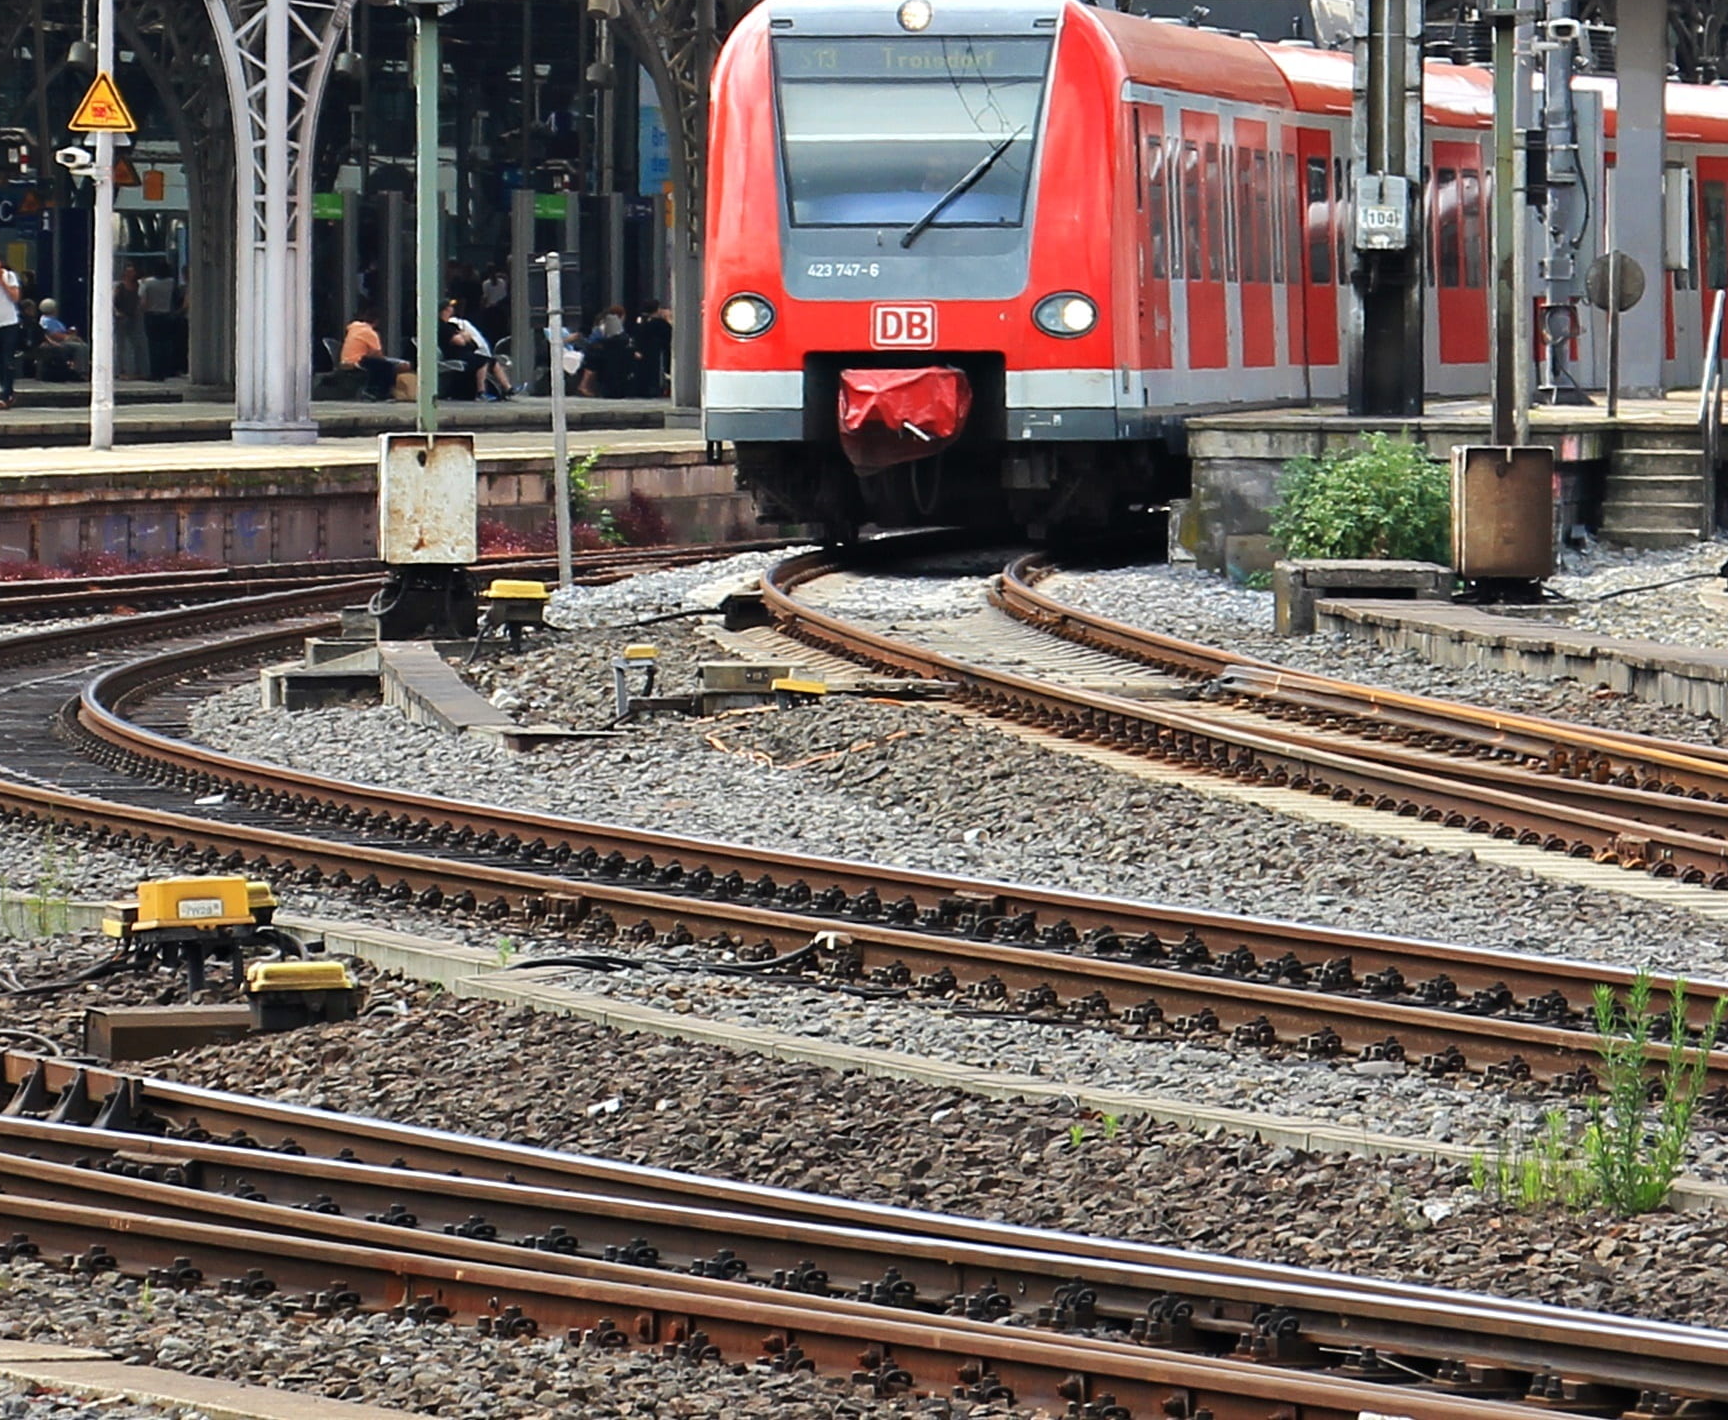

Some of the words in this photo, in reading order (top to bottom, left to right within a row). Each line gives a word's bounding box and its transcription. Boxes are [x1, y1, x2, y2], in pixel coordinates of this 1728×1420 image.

[882, 46, 995, 70] Troisdorf
[1368, 211, 1394, 225] 104
[807, 263, 832, 277] 423
[836, 263, 880, 277] 747-6
[880, 310, 929, 340] DB
